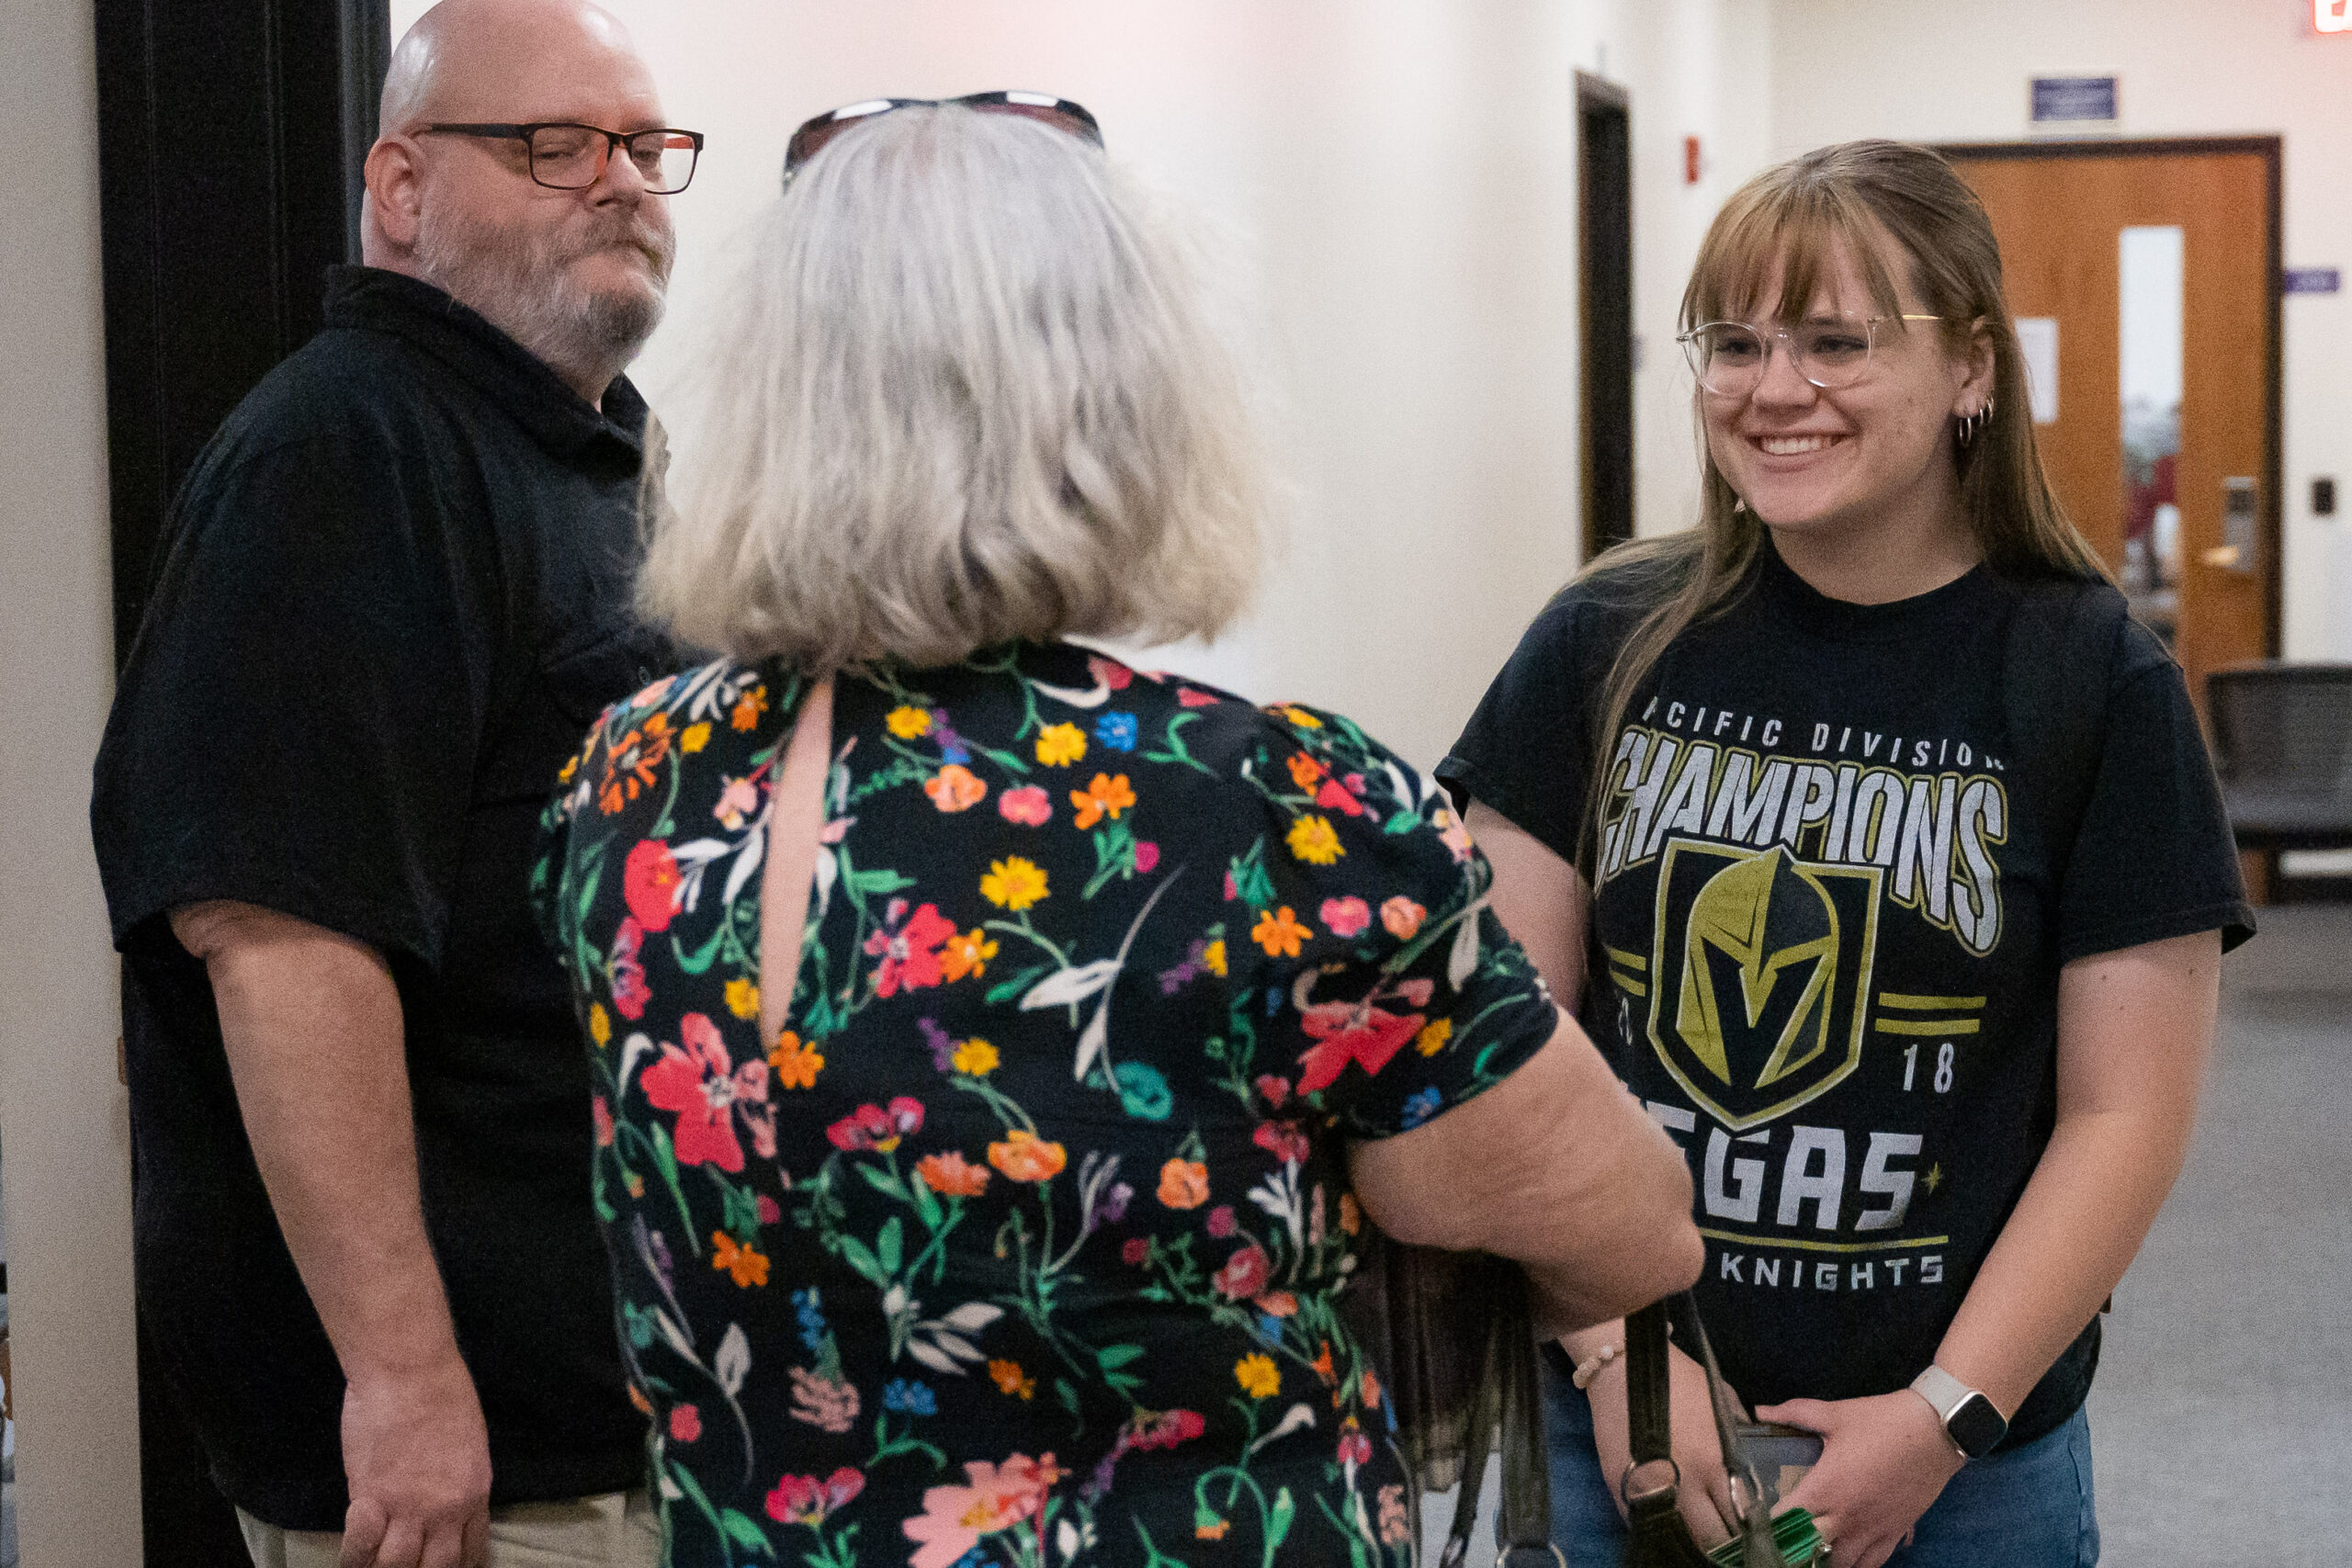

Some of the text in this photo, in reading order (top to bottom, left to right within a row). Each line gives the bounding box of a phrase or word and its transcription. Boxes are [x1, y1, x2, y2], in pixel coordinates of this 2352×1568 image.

[1642, 695, 1782, 747] CIFIC
[1595, 724, 2007, 957] CHAMPIONS
[1903, 1043, 1955, 1093] 18
[1645, 1100, 1924, 1231] GAS
[1721, 1251, 1943, 1291] KNIGHTS
